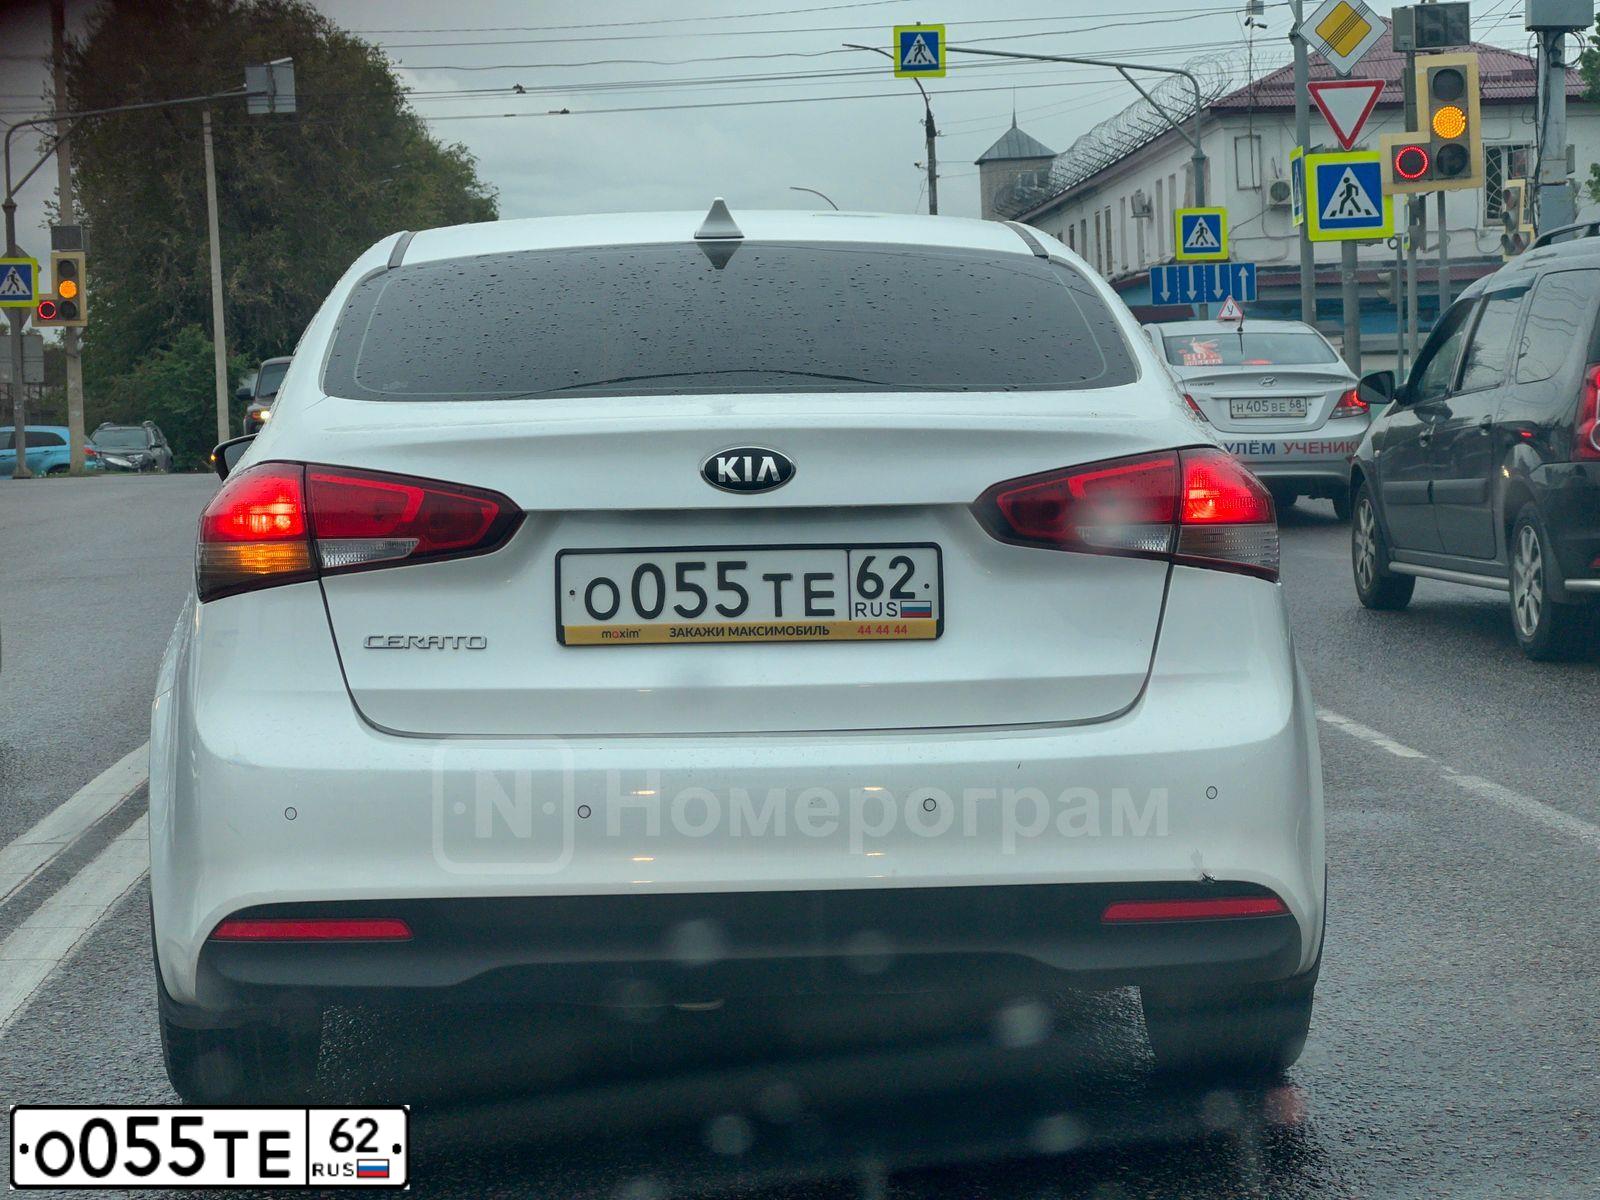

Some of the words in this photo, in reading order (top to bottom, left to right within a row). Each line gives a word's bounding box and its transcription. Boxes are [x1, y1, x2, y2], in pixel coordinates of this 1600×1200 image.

[1227, 305, 1234, 316] У
[1221, 440, 1276, 455] УЛЁМ
[717, 456, 781, 483] KIA
[857, 556, 916, 599] 62
[855, 602, 898, 617] RUS
[601, 629, 640, 639] maxim
[669, 627, 724, 638] ЗАКАЖИ
[728, 625, 830, 637] МАКСИМОБИЛЬ
[857, 624, 872, 635] 44
[875, 624, 889, 635] 44
[893, 624, 908, 635] 44
[363, 634, 487, 650] CERATO
